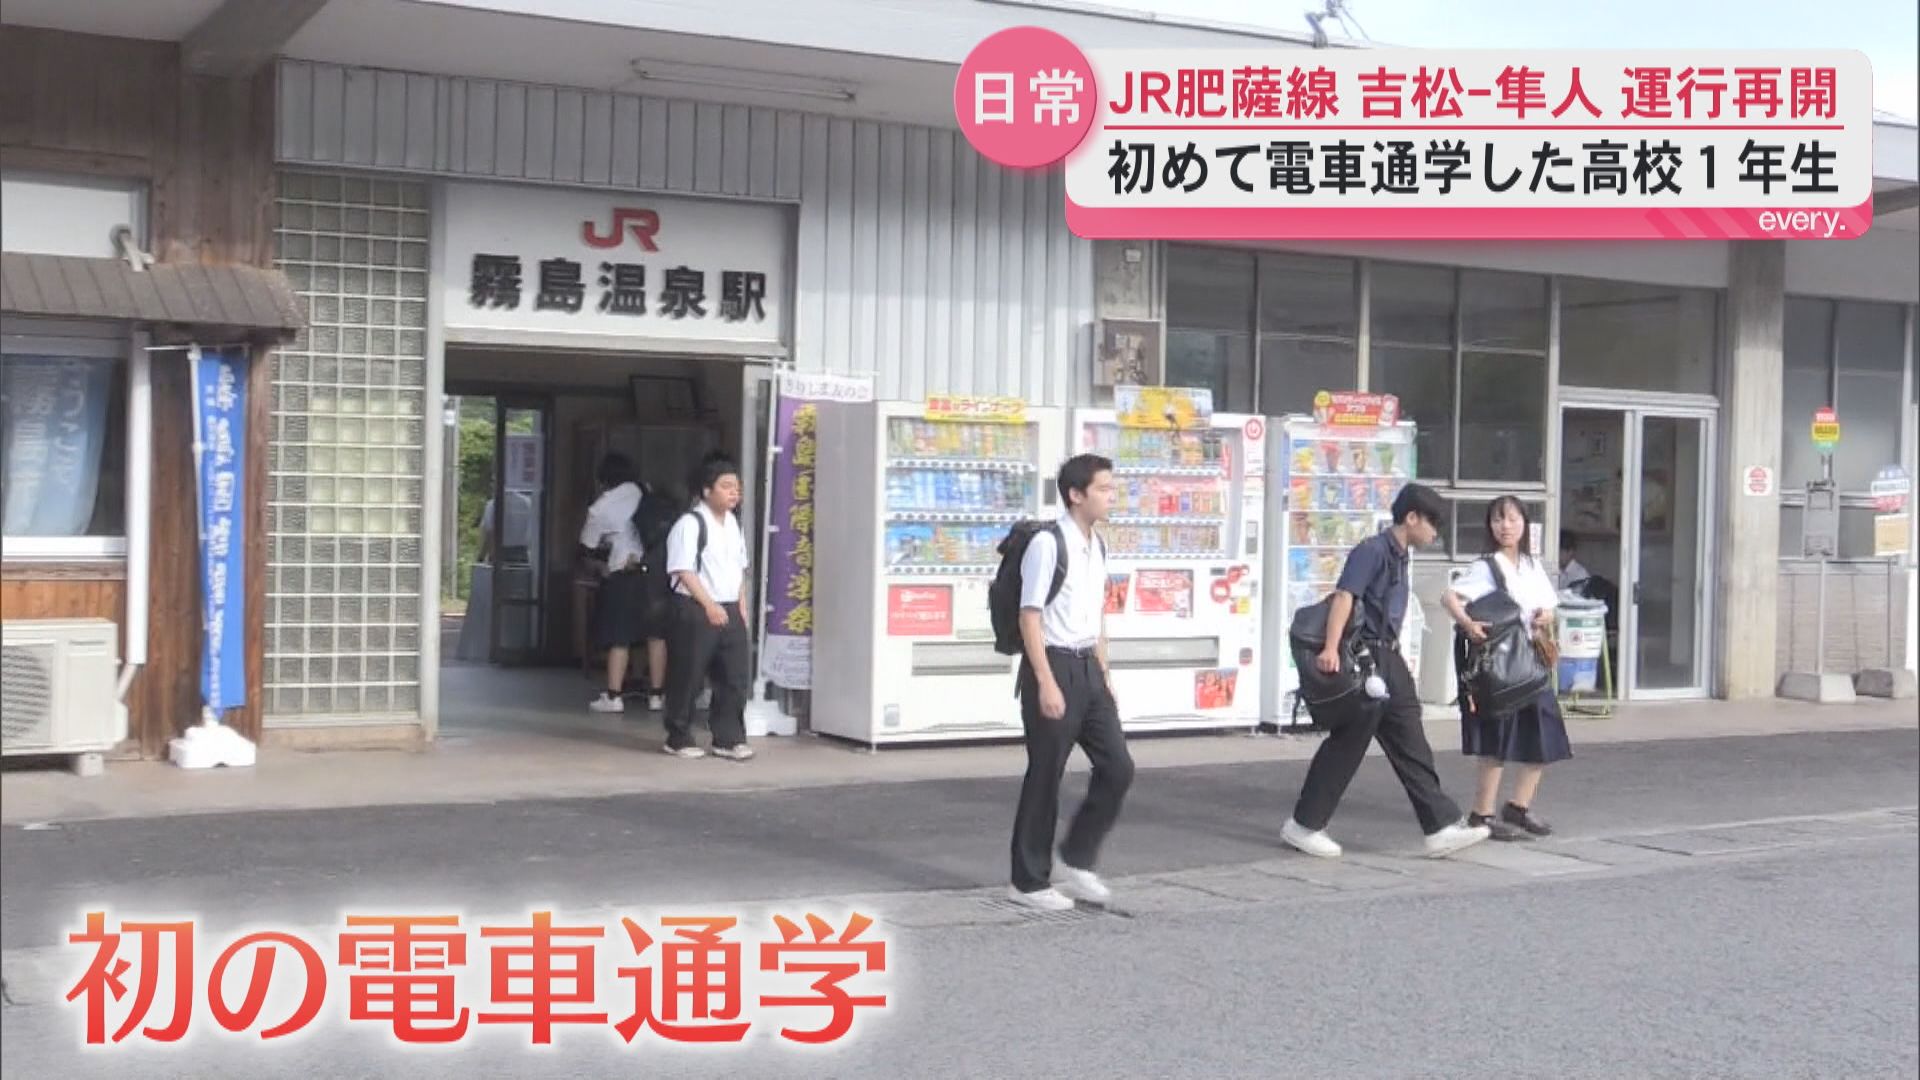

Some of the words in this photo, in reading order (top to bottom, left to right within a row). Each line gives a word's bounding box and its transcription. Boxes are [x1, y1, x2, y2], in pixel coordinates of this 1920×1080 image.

[582, 206, 660, 251] JR
[468, 253, 768, 321] 霧島温泉駅
